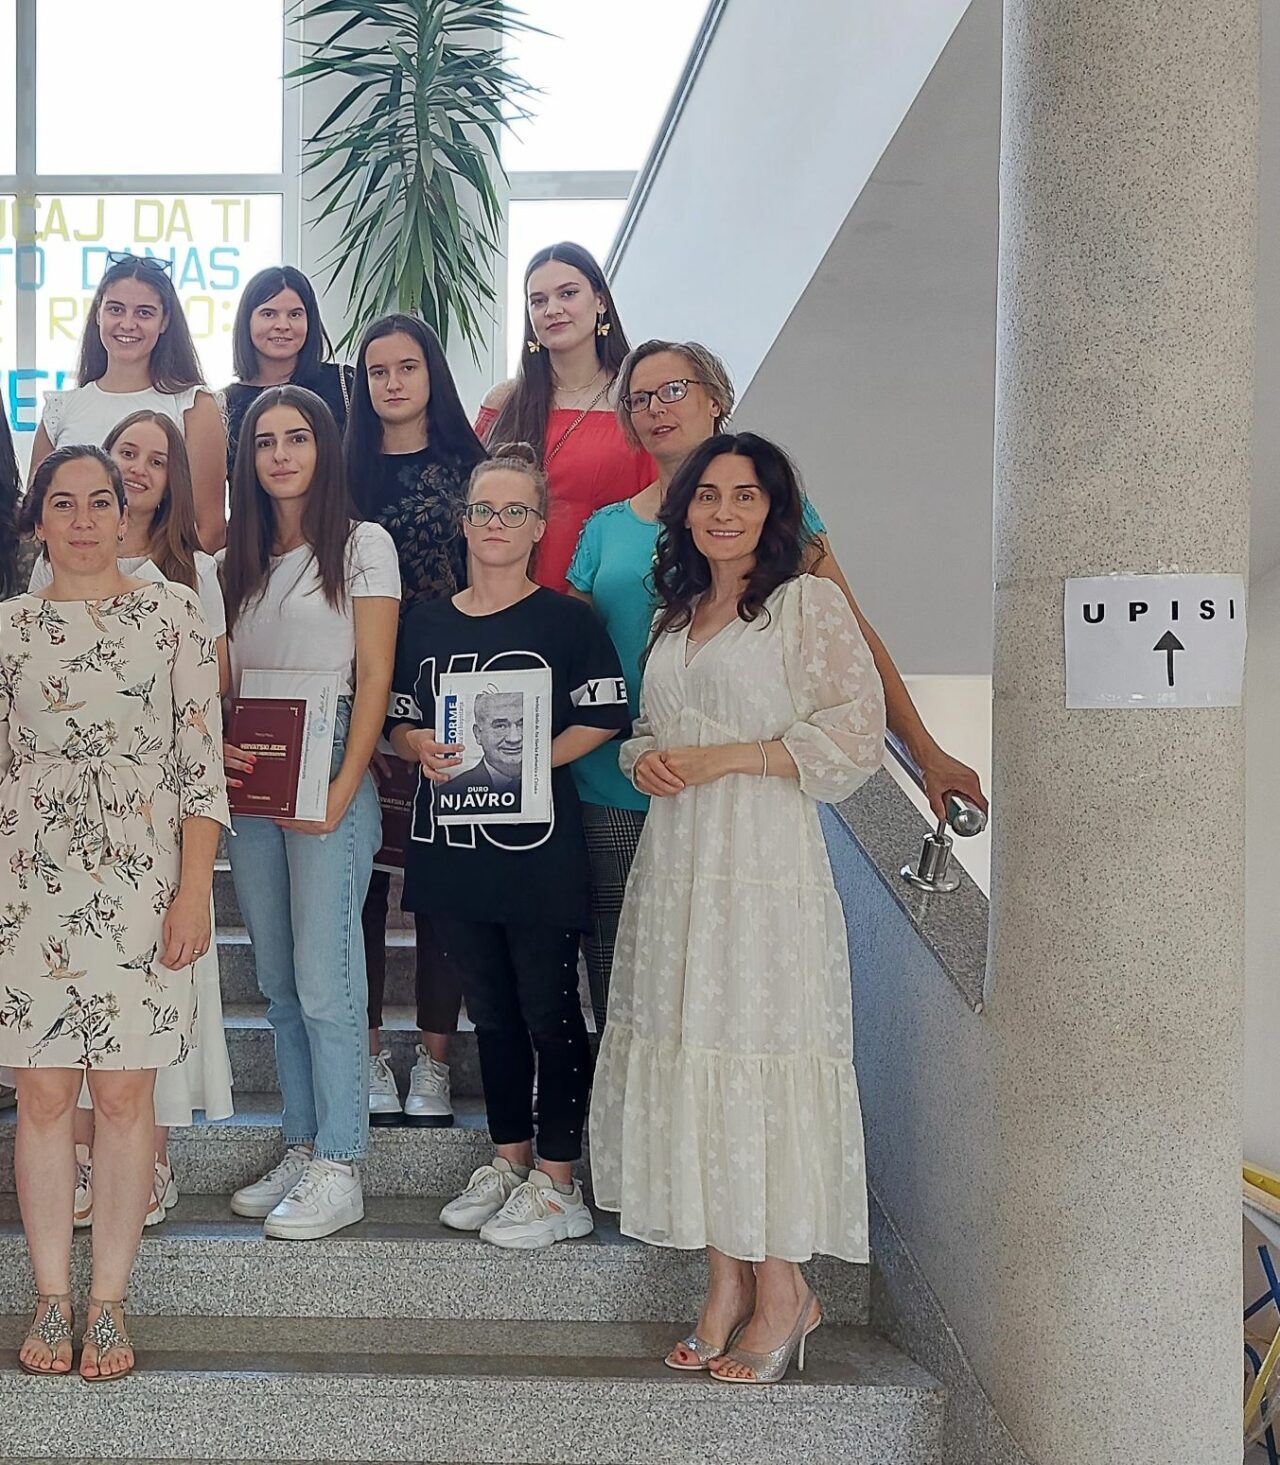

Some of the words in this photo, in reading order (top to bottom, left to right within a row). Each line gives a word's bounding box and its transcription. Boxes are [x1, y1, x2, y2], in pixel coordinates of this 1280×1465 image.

[133, 199, 194, 243] DA
[211, 199, 250, 243] TI
[81, 246, 240, 290] DAS
[1082, 599, 1236, 624] UPISI
[440, 792, 516, 811] NJAVRO
